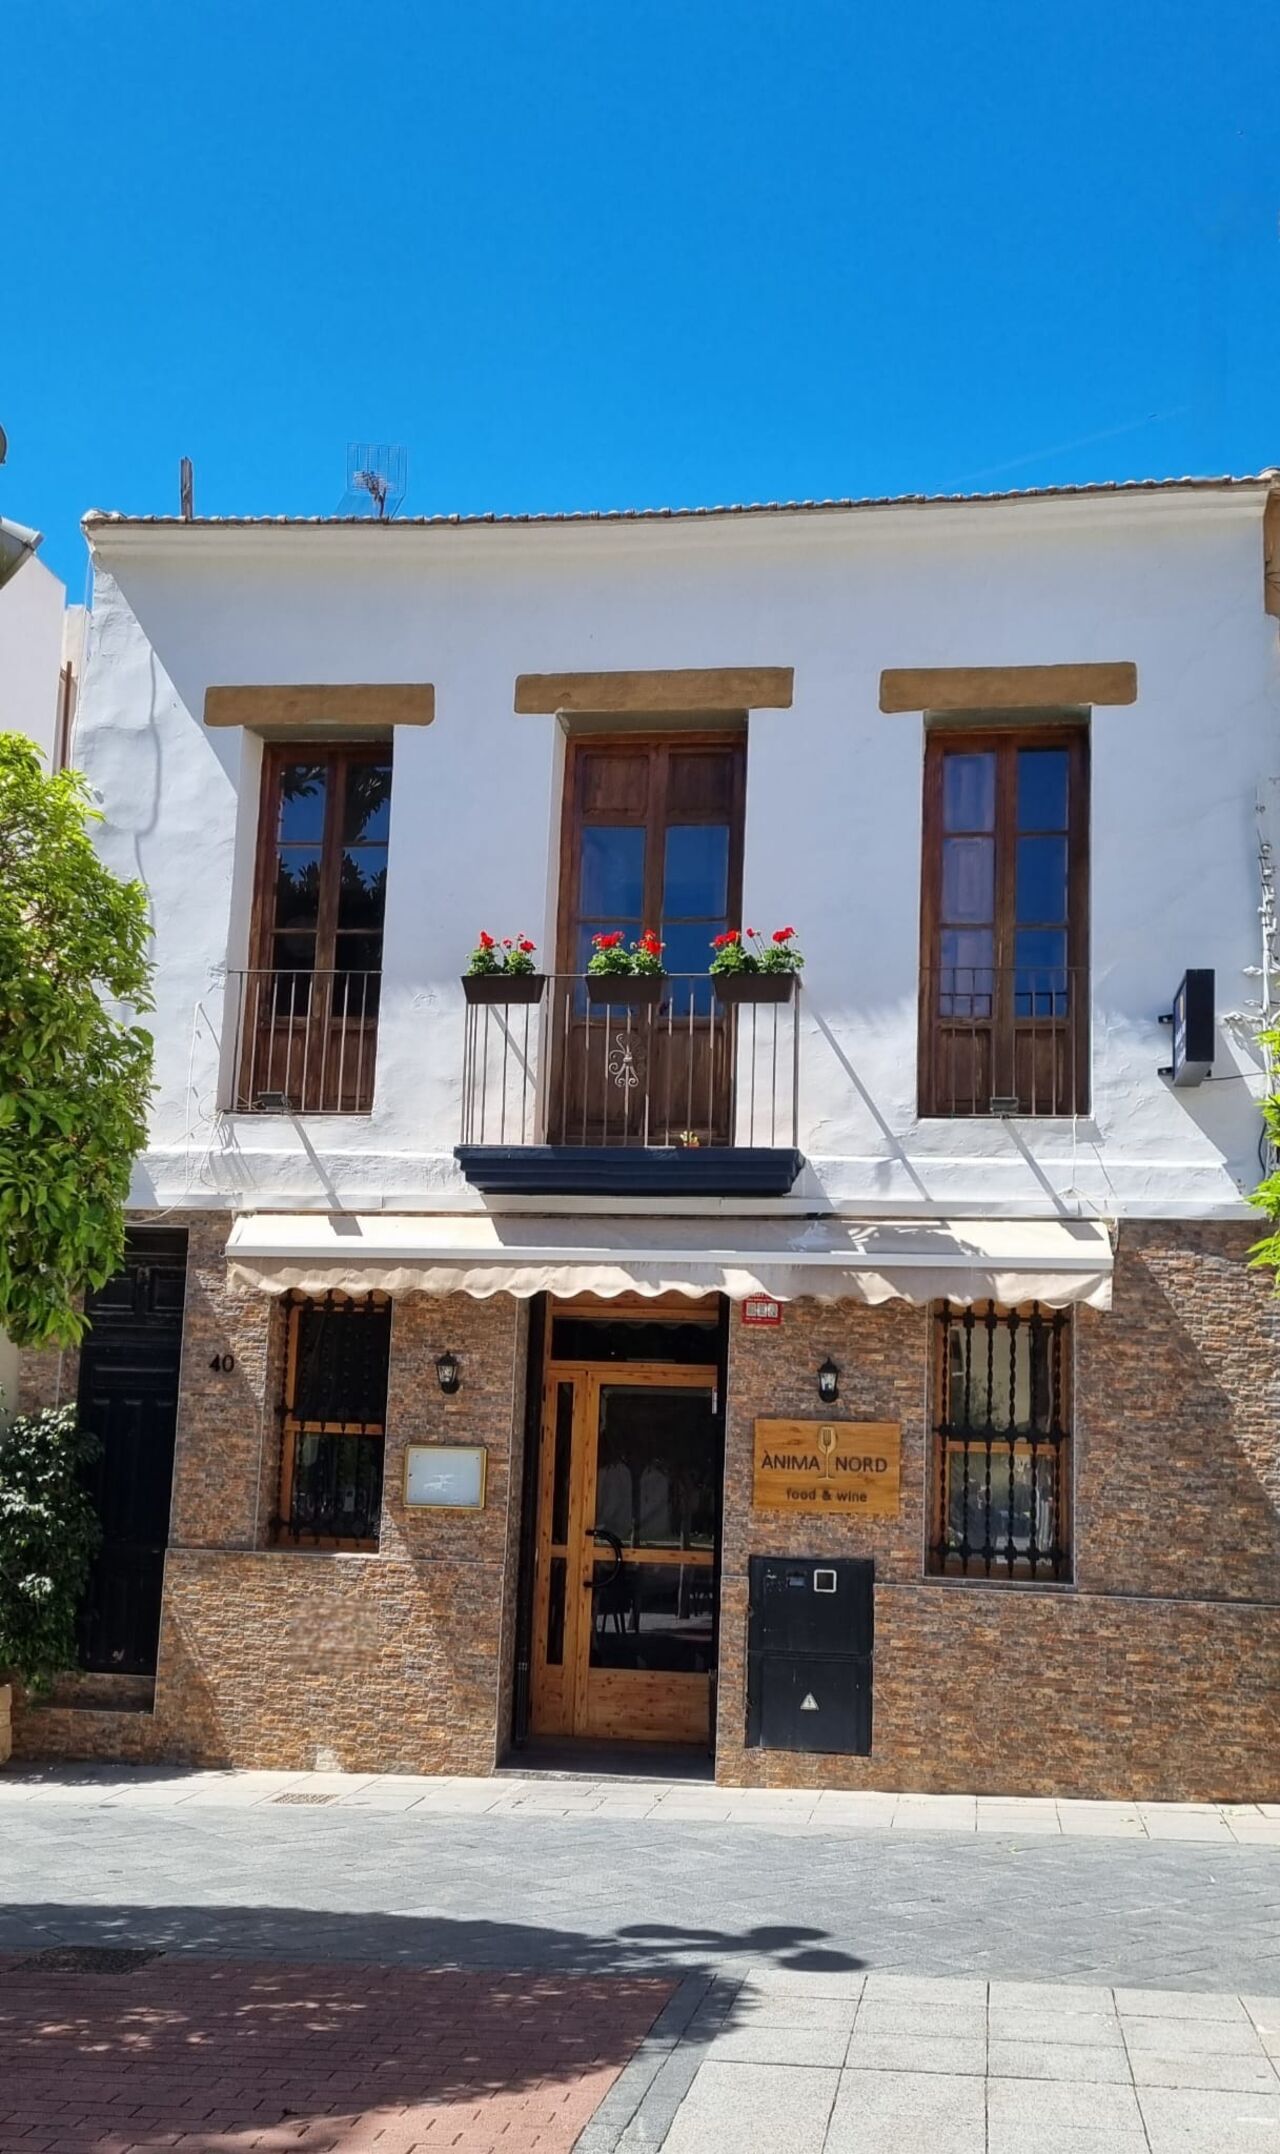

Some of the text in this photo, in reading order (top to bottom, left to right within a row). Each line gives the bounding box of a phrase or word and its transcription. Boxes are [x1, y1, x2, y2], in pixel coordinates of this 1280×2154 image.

[209, 1354, 235, 1373] 40
[762, 1450, 888, 1472] ÀNIMA NORD
[786, 1488, 868, 1502] food & wine
